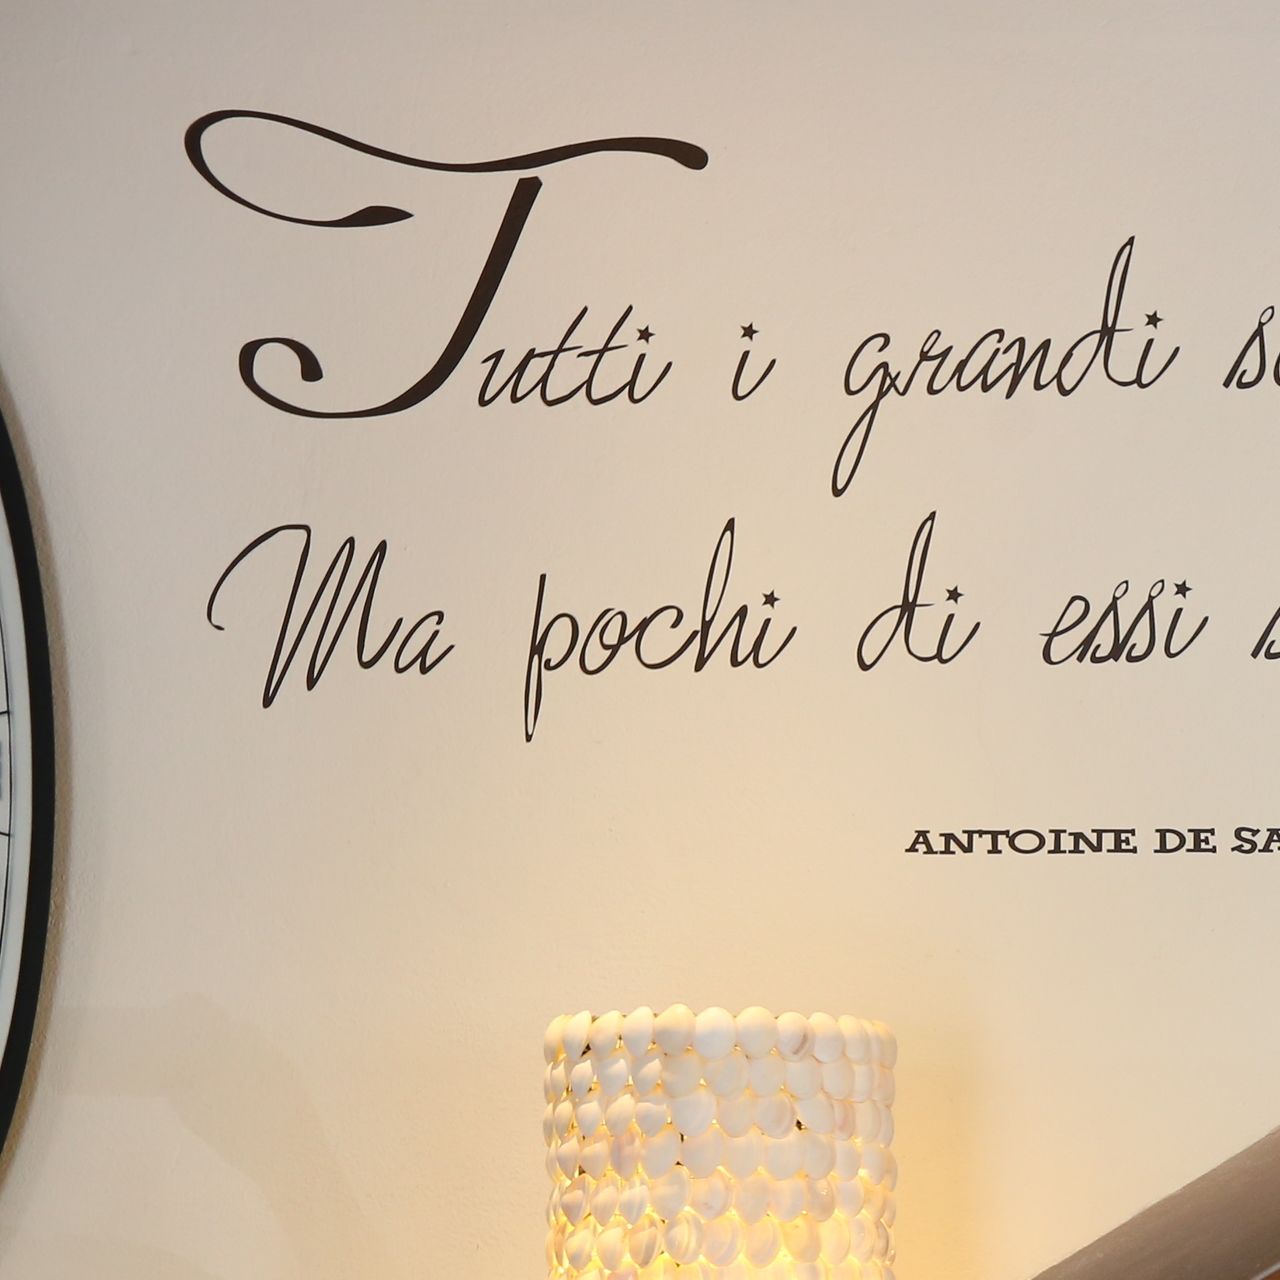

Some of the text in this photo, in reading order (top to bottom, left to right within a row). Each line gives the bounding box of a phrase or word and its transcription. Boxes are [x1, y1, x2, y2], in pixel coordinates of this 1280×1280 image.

[184, 109, 709, 419] Tutti
[731, 322, 777, 402] i
[831, 235, 1180, 498] grandi
[206, 524, 455, 709] Ma
[524, 517, 797, 743] pochi
[856, 510, 981, 672] di
[1040, 579, 1209, 666] essi
[904, 828, 1138, 855] ANTOINE
[1153, 827, 1217, 854] DE
